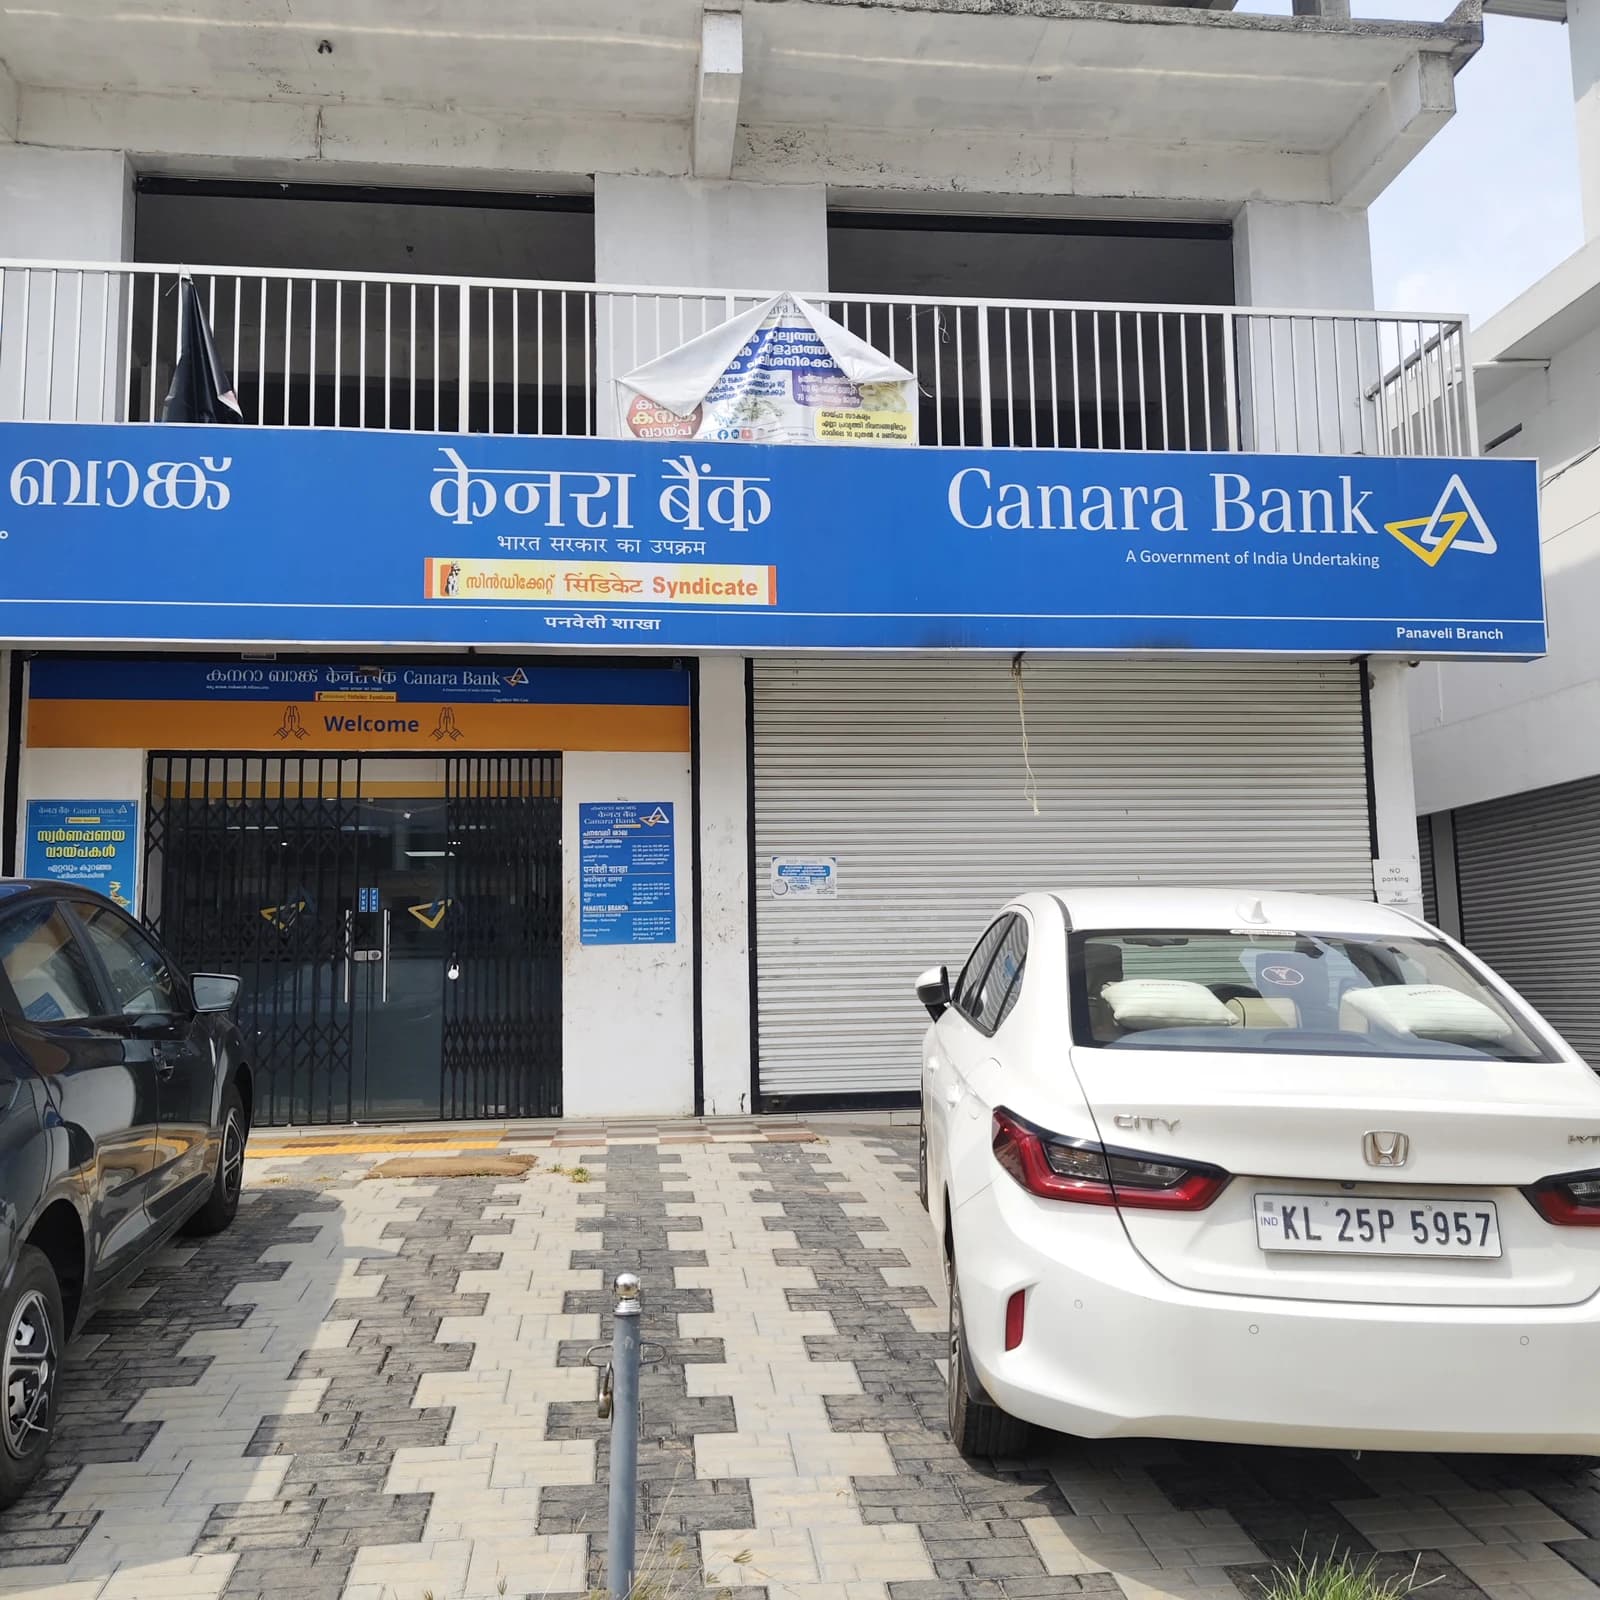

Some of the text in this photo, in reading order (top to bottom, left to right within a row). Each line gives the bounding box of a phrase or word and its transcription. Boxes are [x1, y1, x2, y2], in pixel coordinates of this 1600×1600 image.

[9, 456, 233, 511] ബാങ്ക്
[429, 447, 772, 532] केनरा बैंक
[947, 466, 1379, 535] Canara Bank
[497, 535, 707, 556] भारत सरकार का उपक्रम
[1125, 550, 1380, 569] A Government of India Undertaking
[563, 572, 643, 593] सिंडिकेट
[652, 576, 758, 598] Syndicate
[544, 613, 661, 631] पनवेली शाखा
[1396, 627, 1504, 640] Panaveli Branch
[403, 669, 460, 686] Canara
[463, 671, 501, 686] Bank
[323, 714, 419, 733] Welcome
[1113, 1113, 1181, 1133] CITY
[1260, 1215, 1279, 1227] IND
[1281, 1205, 1490, 1247] KL 25P 5957
